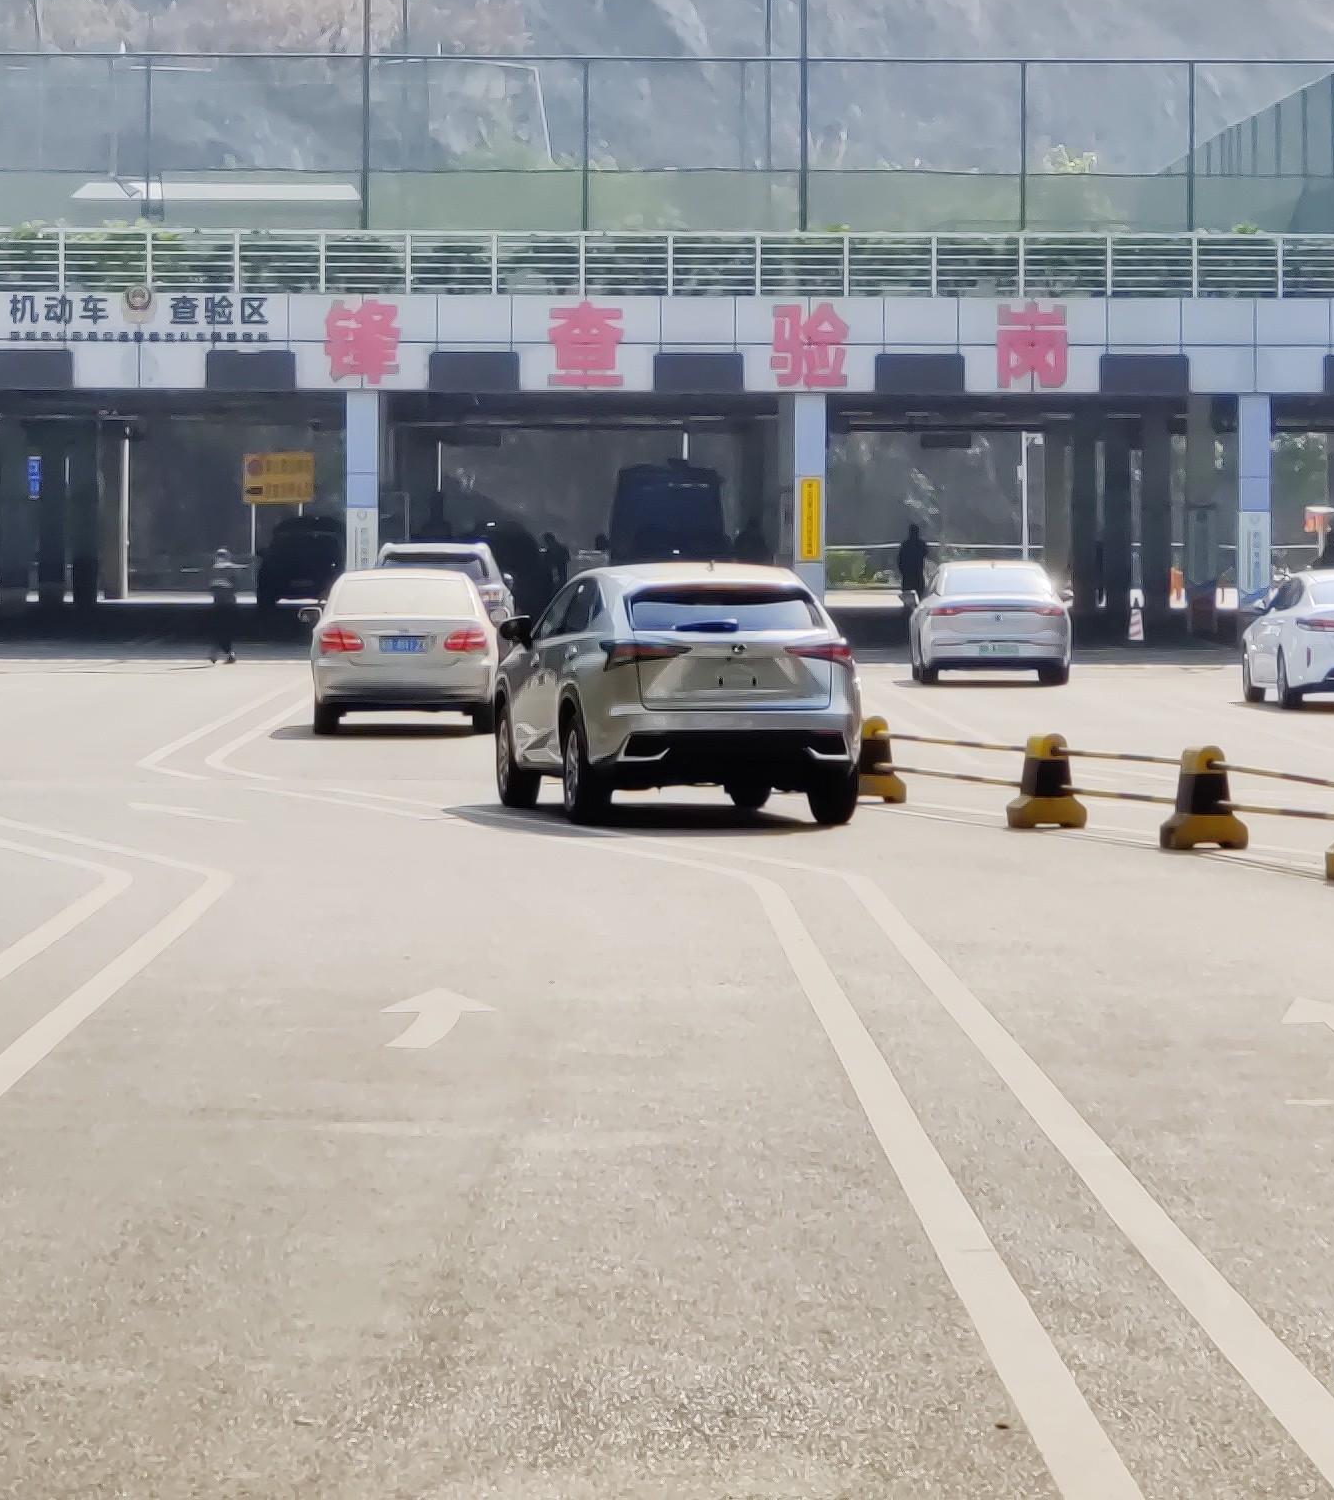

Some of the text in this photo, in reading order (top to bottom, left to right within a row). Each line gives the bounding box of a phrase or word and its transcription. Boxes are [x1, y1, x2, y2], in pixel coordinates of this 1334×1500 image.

[9, 294, 269, 325] 机动车 查验区
